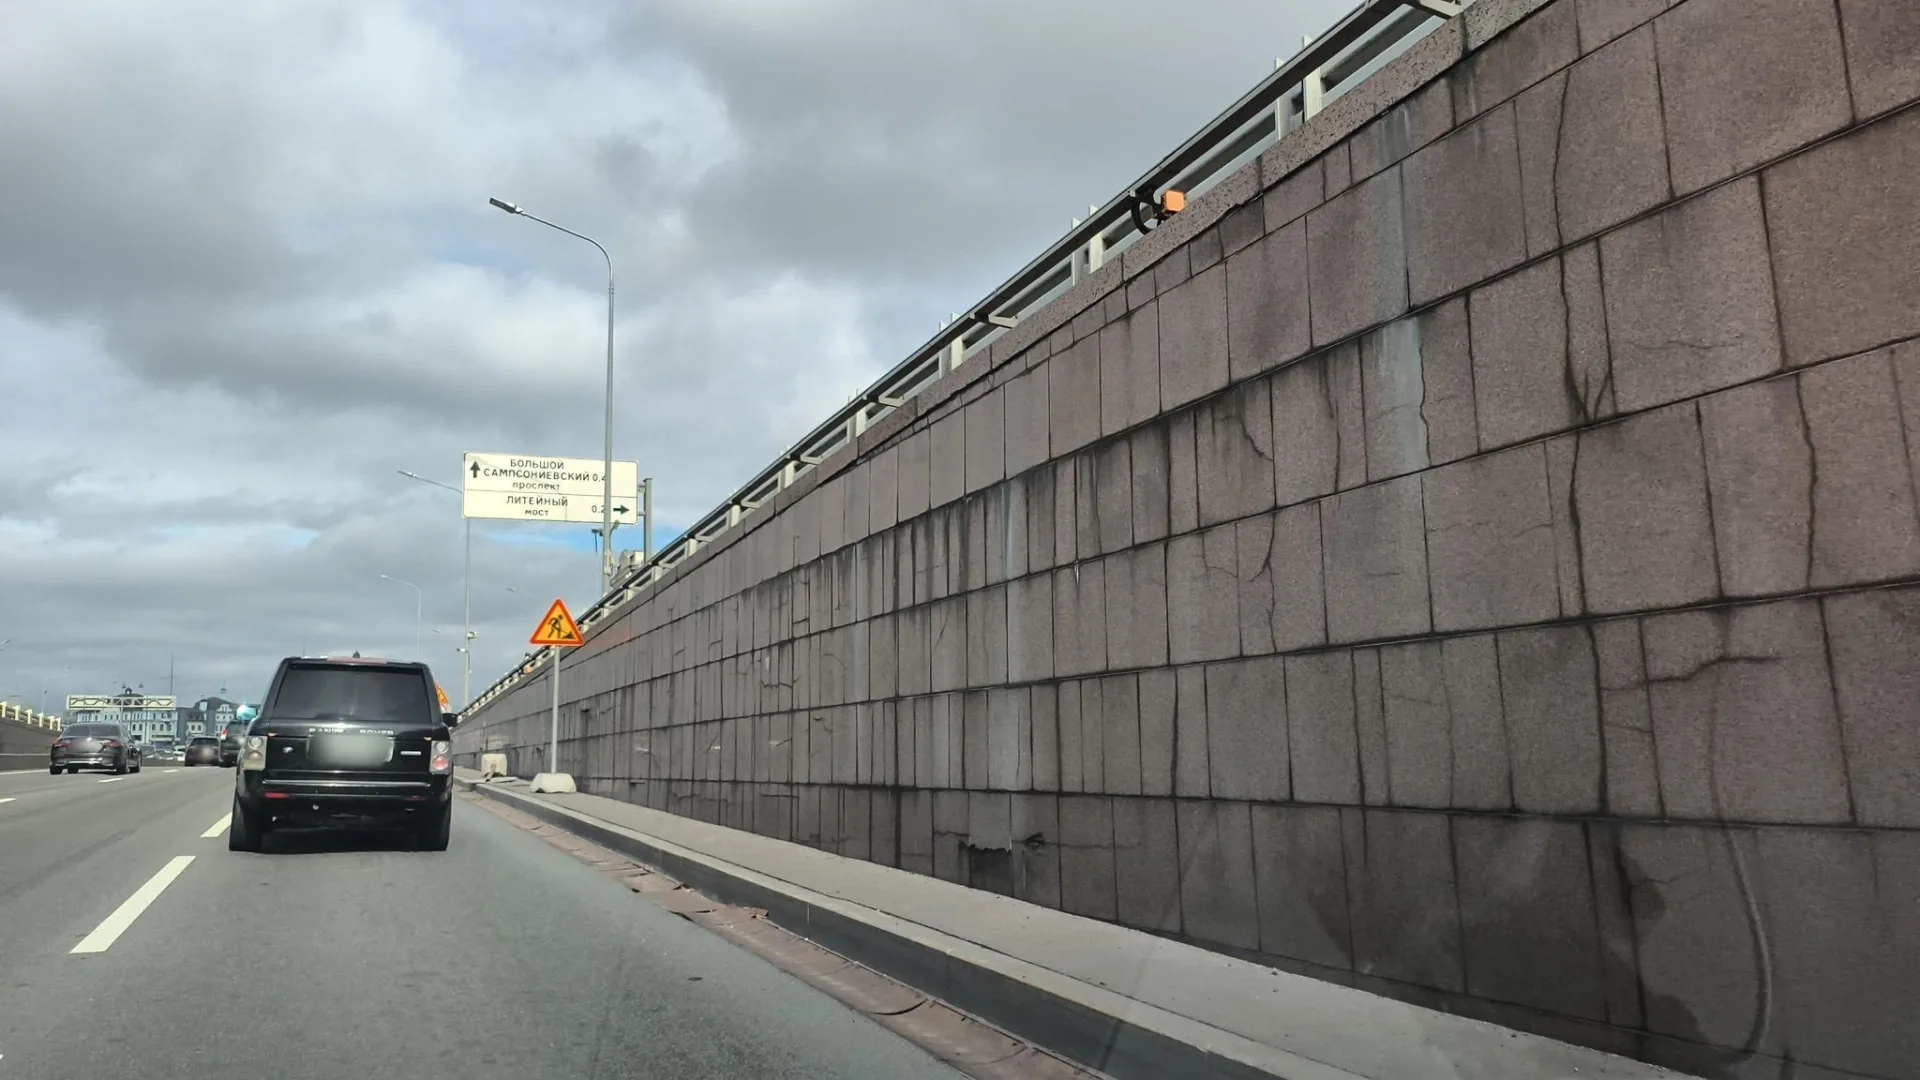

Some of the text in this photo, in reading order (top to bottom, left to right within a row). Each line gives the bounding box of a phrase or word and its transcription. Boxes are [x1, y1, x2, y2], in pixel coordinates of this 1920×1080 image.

[510, 459, 564, 469] БОЛЬШОЙ
[483, 468, 590, 482] САМПСОНИЕВСКИЙ
[512, 482, 561, 491] проспект
[506, 495, 568, 506] ЛИТЕЙНЫЙ
